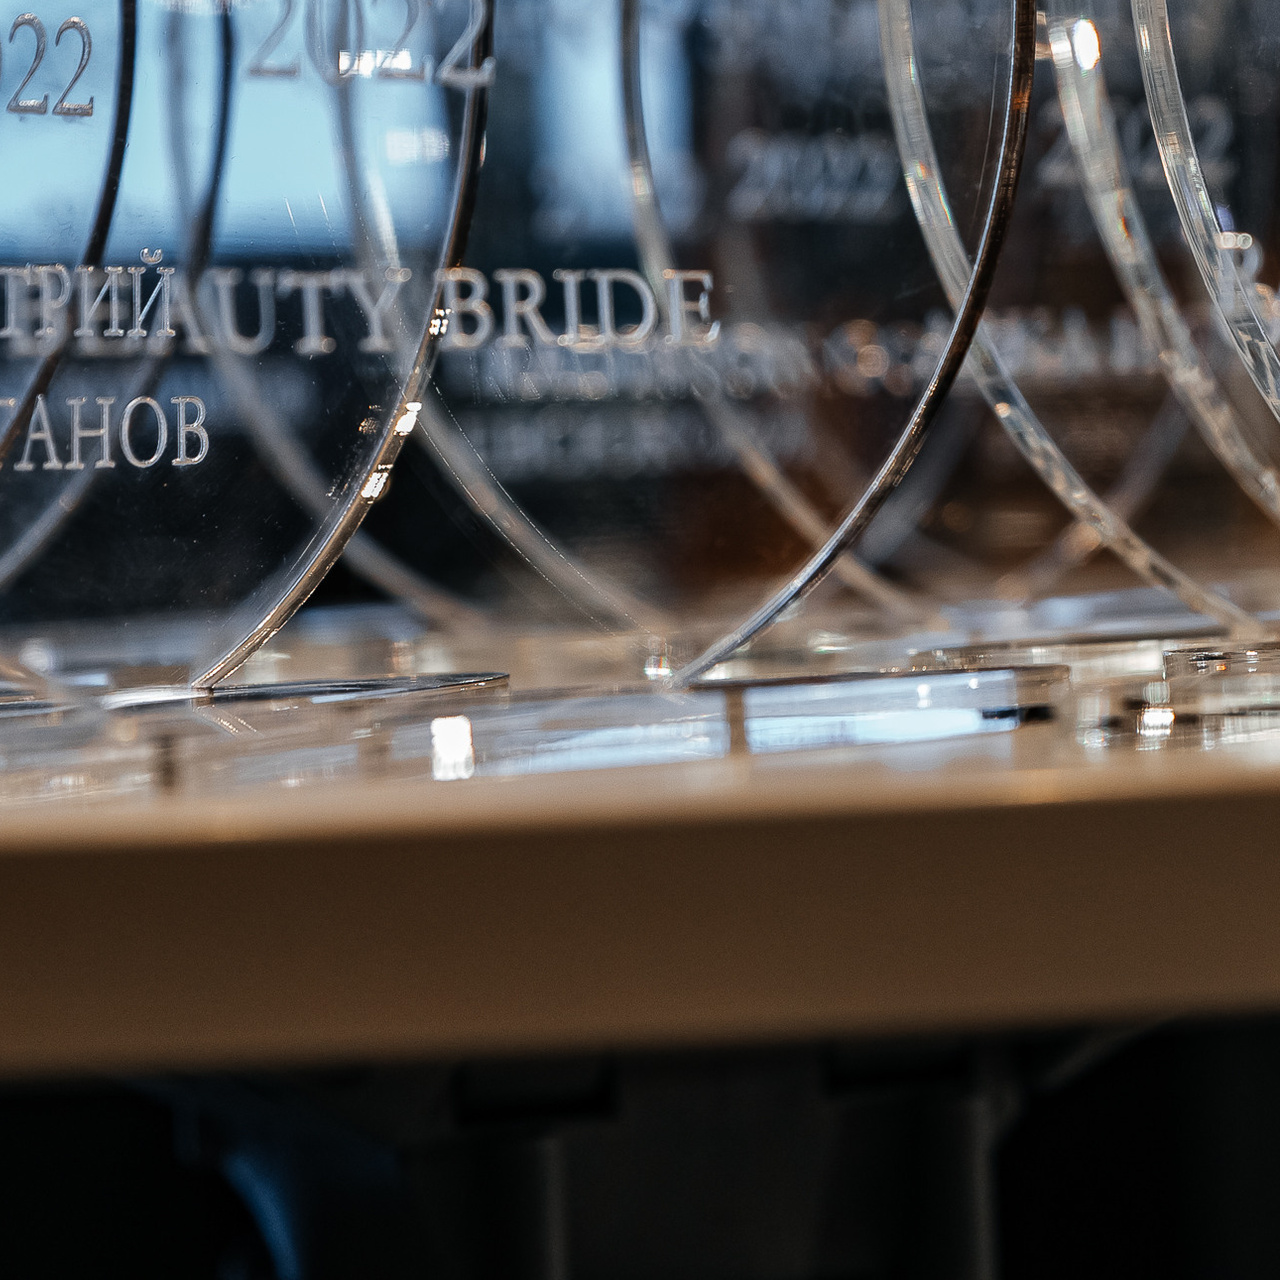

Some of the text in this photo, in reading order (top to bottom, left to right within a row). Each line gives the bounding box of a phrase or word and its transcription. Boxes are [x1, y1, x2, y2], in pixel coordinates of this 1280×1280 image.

[8, 13, 94, 117] 22
[436, 267, 721, 352] BRIDE
[0, 393, 210, 471] АНОВ
